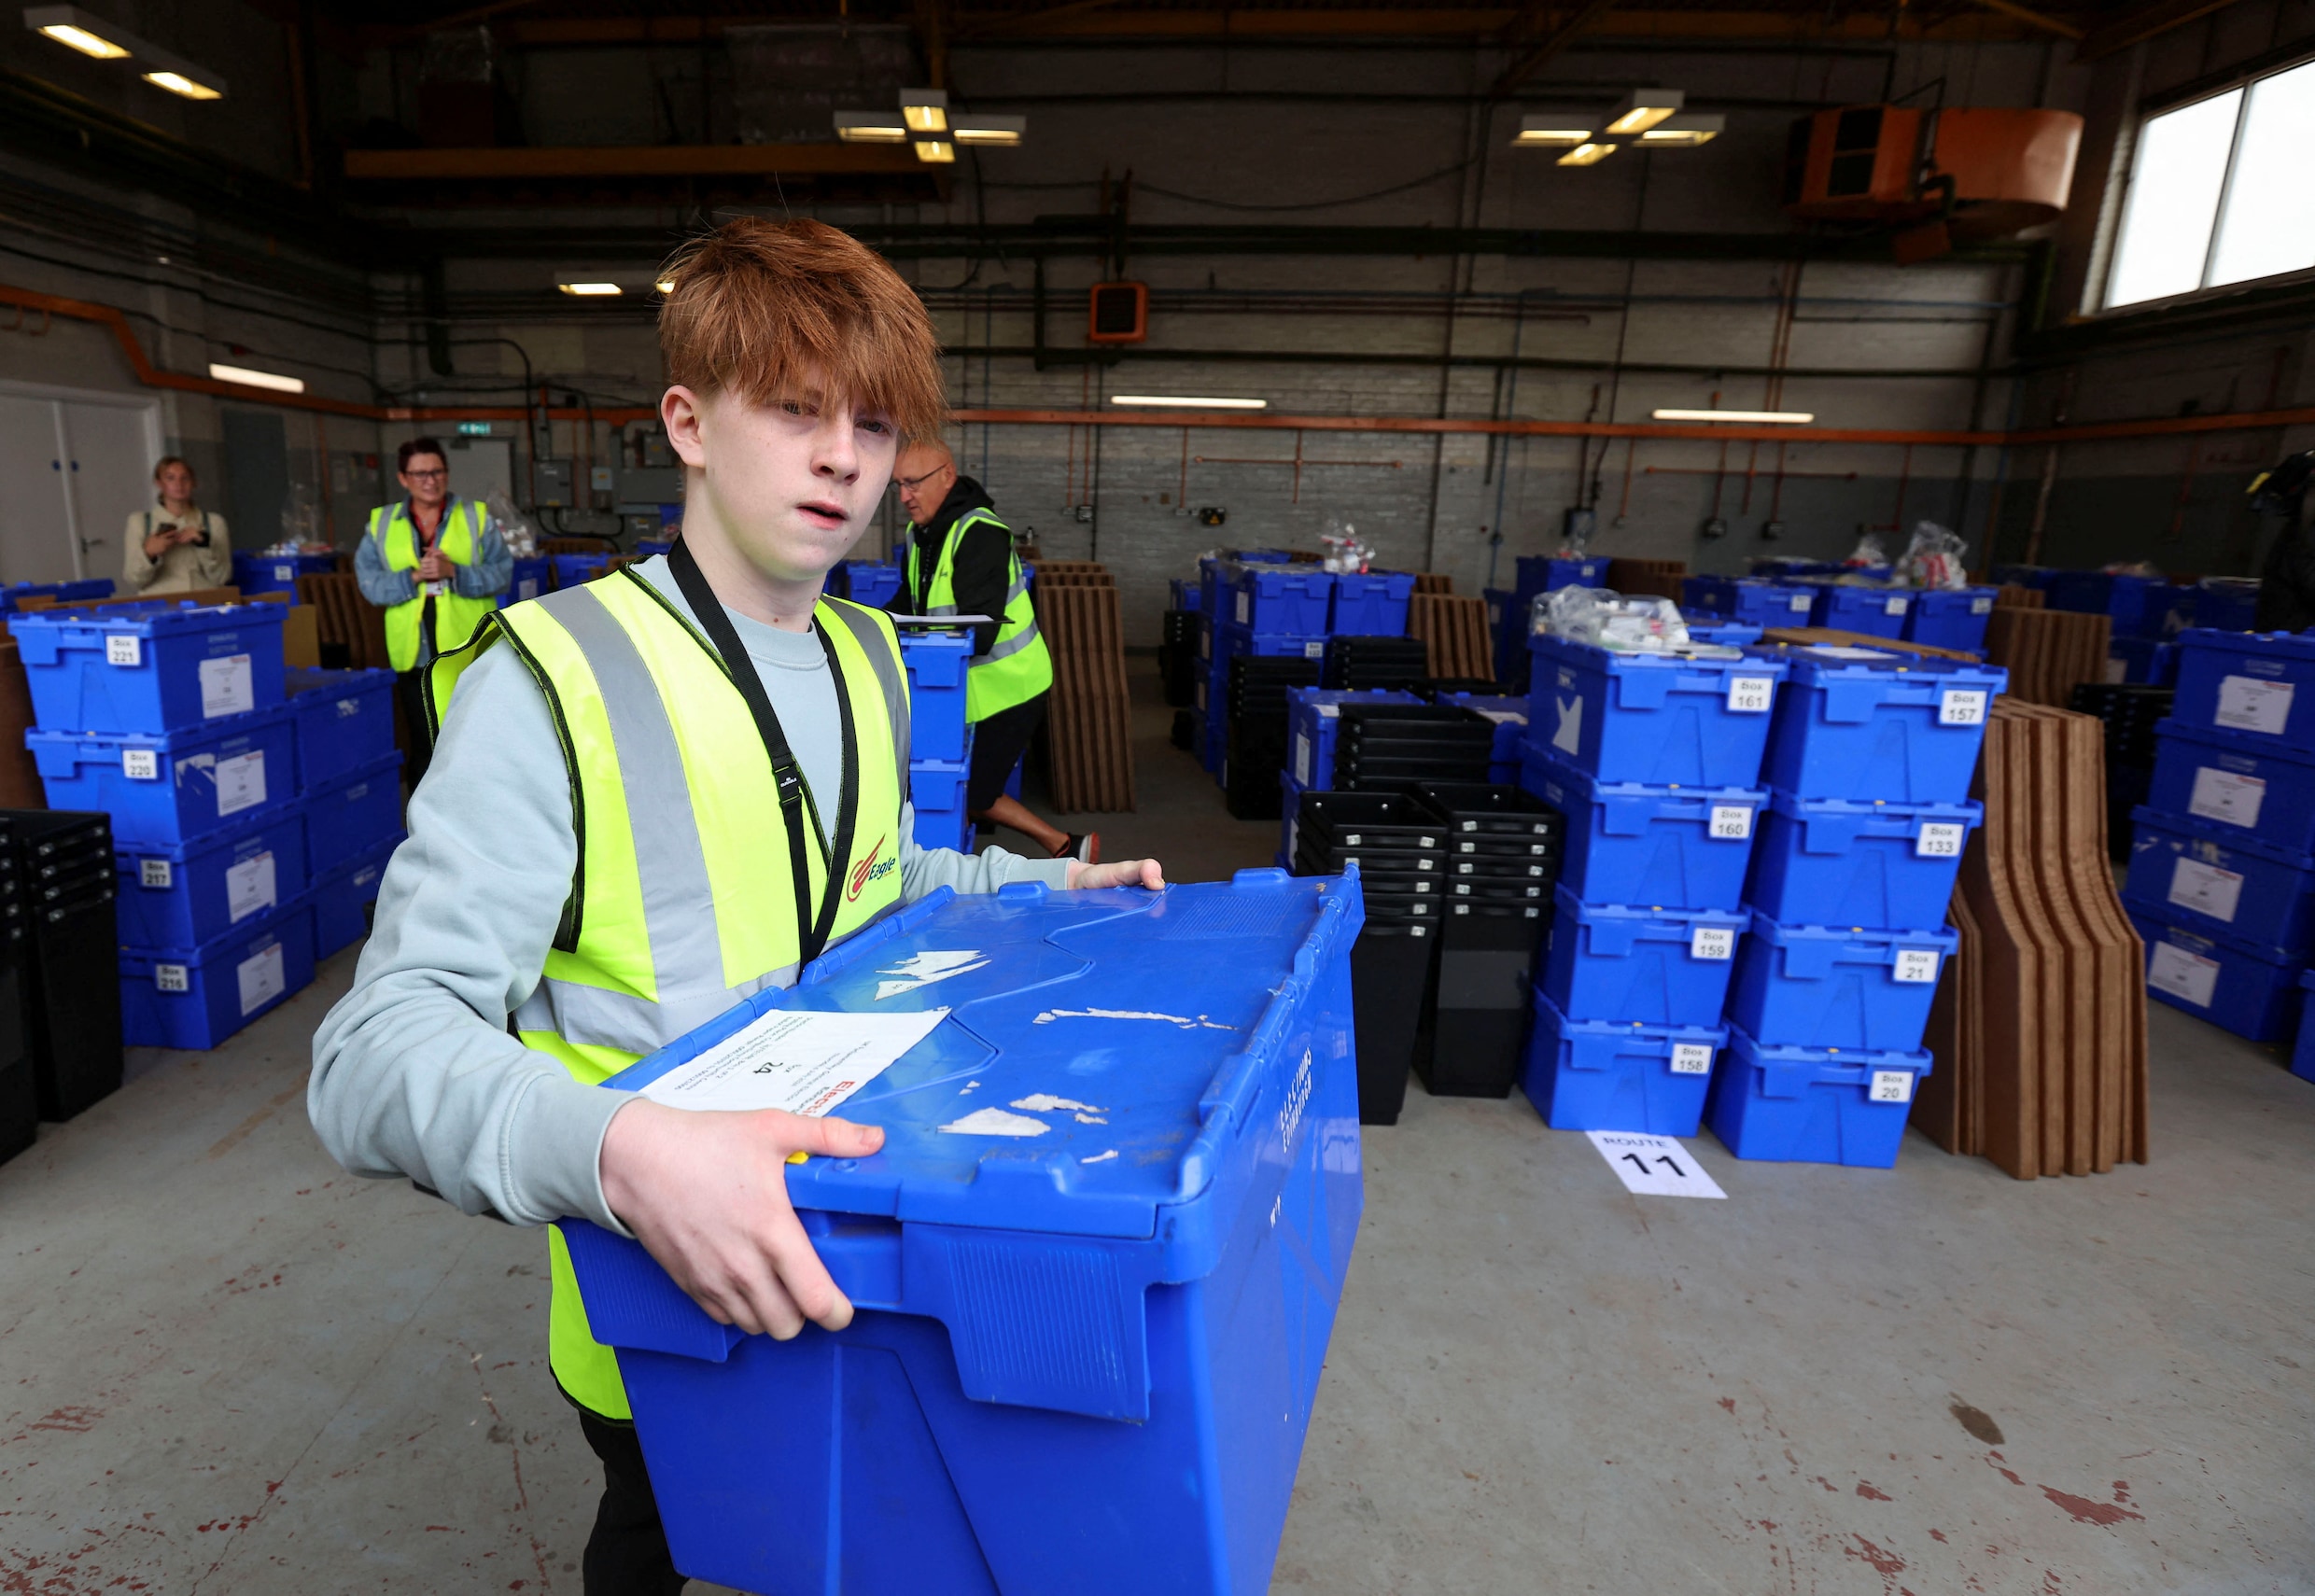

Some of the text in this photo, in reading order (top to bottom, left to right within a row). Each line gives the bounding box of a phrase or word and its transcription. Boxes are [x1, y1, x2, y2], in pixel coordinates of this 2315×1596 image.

[1740, 680, 1762, 691] Box
[1738, 695, 1762, 707] 161
[1953, 693, 1976, 703] Box
[1950, 708, 1976, 721] 157
[1720, 809, 1742, 819] Box
[1719, 823, 1743, 835] 160
[1930, 826, 1953, 836] Box
[1928, 840, 1953, 853] 133
[868, 856, 896, 881] Eagle
[1704, 931, 1724, 941] Box
[1701, 945, 1724, 957] 159
[1907, 953, 1929, 962] Box
[1906, 967, 1923, 979] 21
[1682, 1046, 1704, 1056] Box
[752, 1062, 783, 1074] 24
[1680, 1059, 1704, 1071] 158
[1883, 1073, 1903, 1084] Box
[1280, 1045, 1312, 1131] ELECTIONS
[1882, 1087, 1901, 1099] 20
[790, 1086, 830, 1114] Edinburg
[802, 1081, 856, 1117] Electi
[1603, 1137, 1669, 1148] ROUTE
[1621, 1154, 1687, 1177] 11
